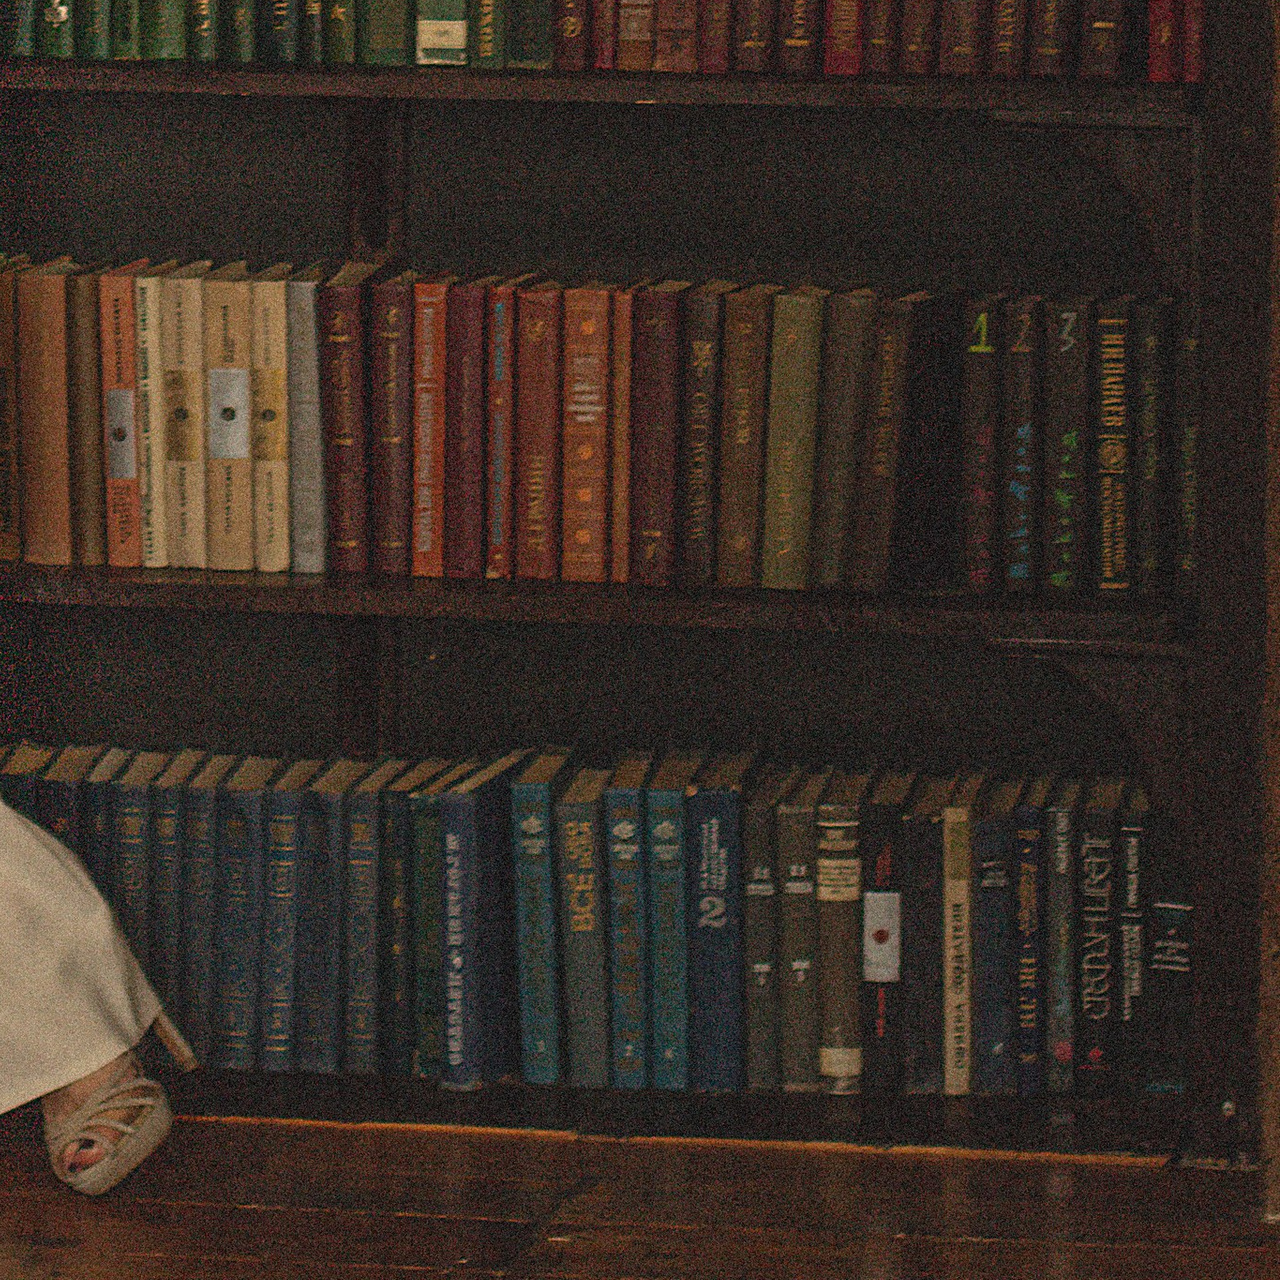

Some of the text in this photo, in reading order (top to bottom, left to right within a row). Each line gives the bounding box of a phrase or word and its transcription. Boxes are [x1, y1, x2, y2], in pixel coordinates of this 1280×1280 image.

[966, 311, 995, 353] 1
[1010, 312, 1032, 352] 2
[1058, 311, 1077, 353] 3
